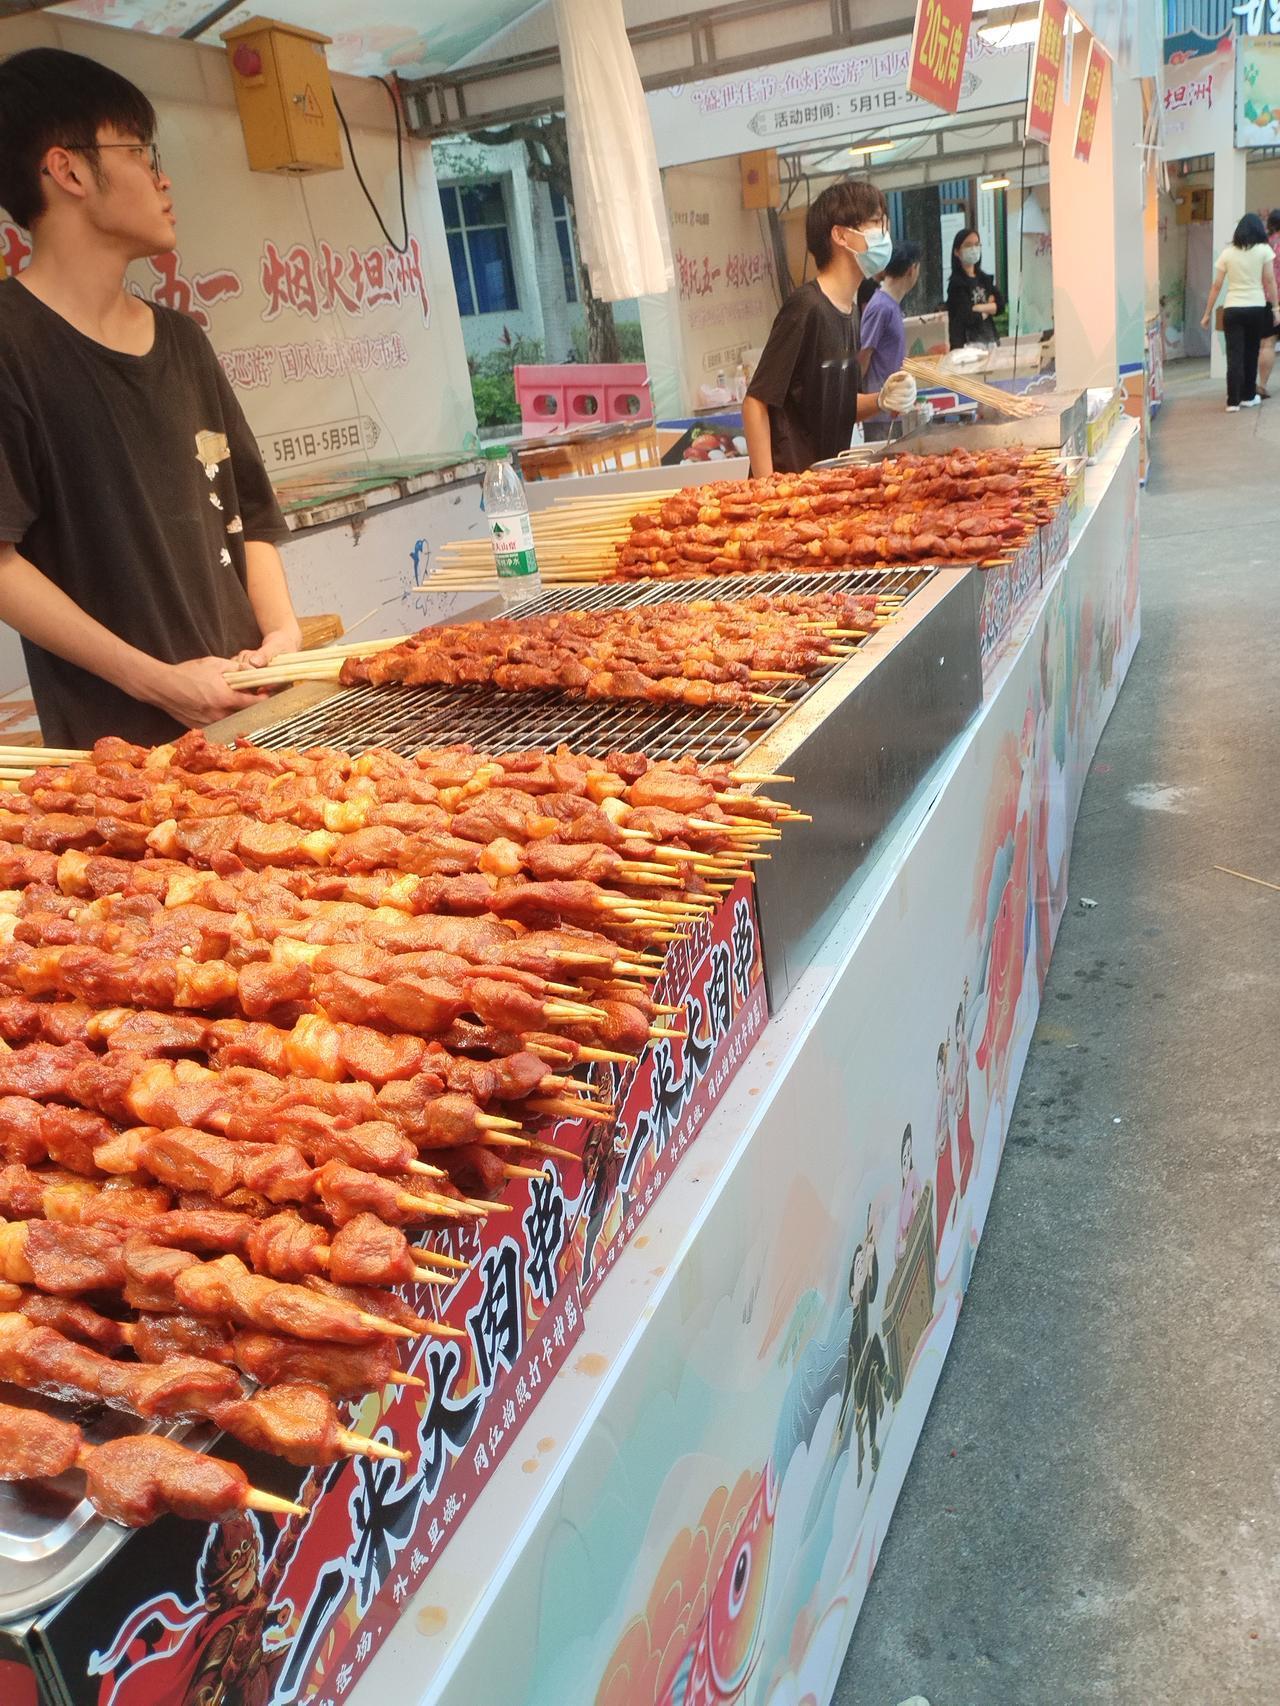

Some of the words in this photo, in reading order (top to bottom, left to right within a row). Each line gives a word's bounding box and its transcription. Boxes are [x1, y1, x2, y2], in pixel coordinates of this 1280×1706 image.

[919, 0, 964, 90] 20元/串
[774, 88, 922, 129] 活动时间：5月1日-5
[261, 238, 430, 319] 烟火坦洲
[620, 900, 757, 1190] 一米大肉串
[277, 1167, 565, 1695] 一米大肉串
